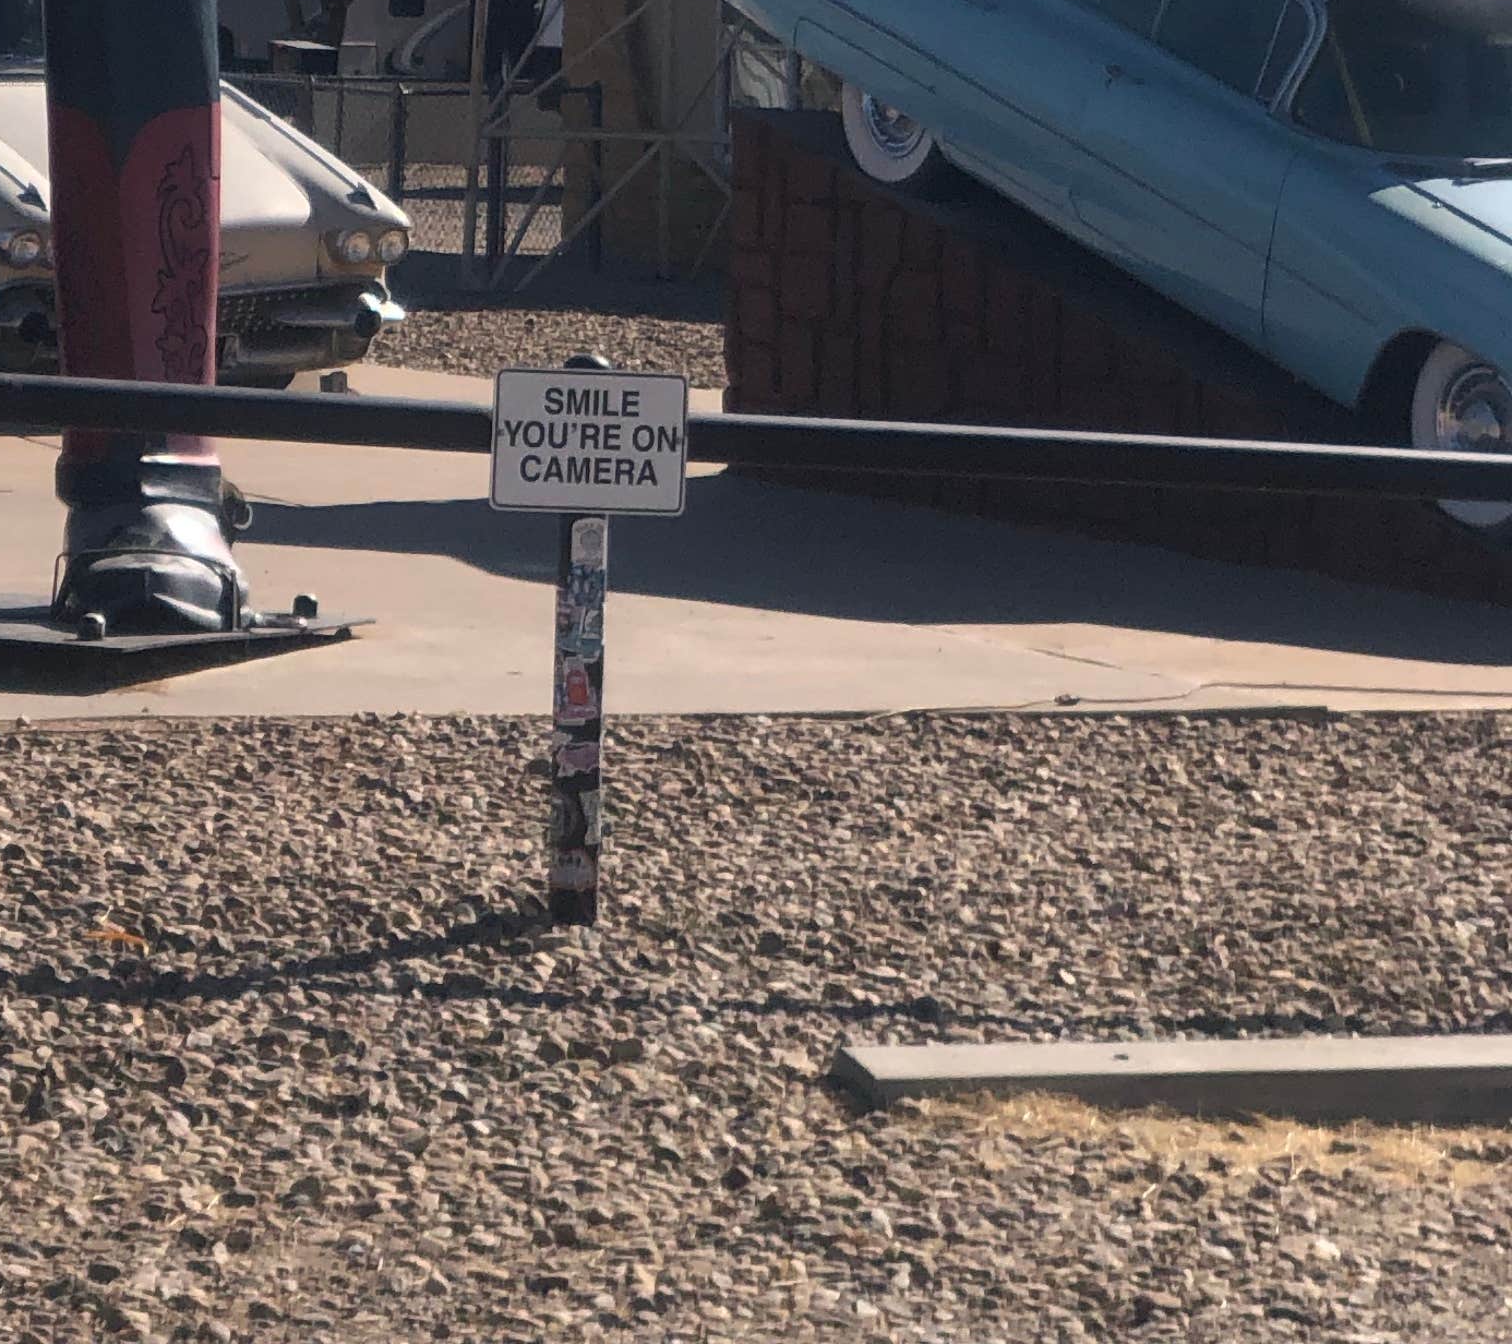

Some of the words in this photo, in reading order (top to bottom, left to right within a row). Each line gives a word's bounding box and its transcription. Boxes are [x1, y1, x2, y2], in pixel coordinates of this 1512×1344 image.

[543, 387, 641, 418] SMILE
[502, 419, 622, 450] YOU'RE
[631, 424, 678, 453] ON
[518, 454, 659, 487] CAMERA
